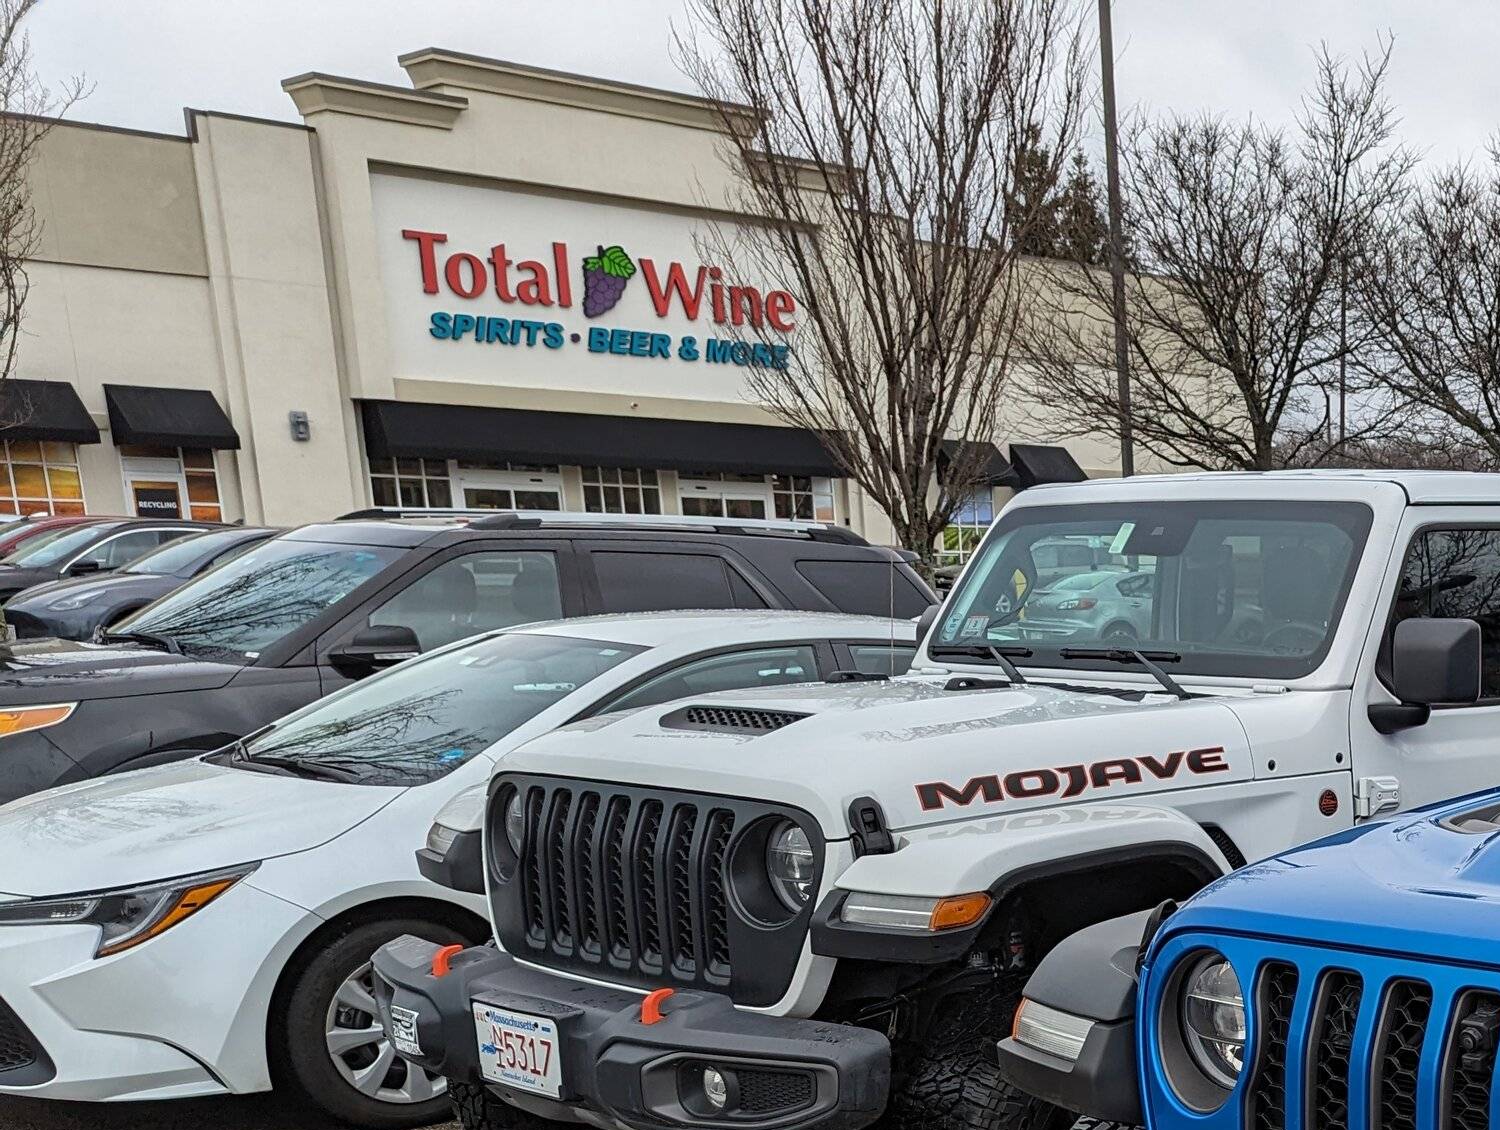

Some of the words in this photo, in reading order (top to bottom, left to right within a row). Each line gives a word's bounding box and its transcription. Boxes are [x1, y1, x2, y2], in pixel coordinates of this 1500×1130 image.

[402, 229, 572, 308] Total
[639, 258, 797, 332] Wine
[430, 312, 564, 349] SPIRITS
[588, 327, 671, 359] BEER
[678, 336, 699, 361] &
[706, 338, 790, 370] MORE
[138, 501, 177, 509] RECYCLING
[914, 746, 1230, 812] MOJAVE
